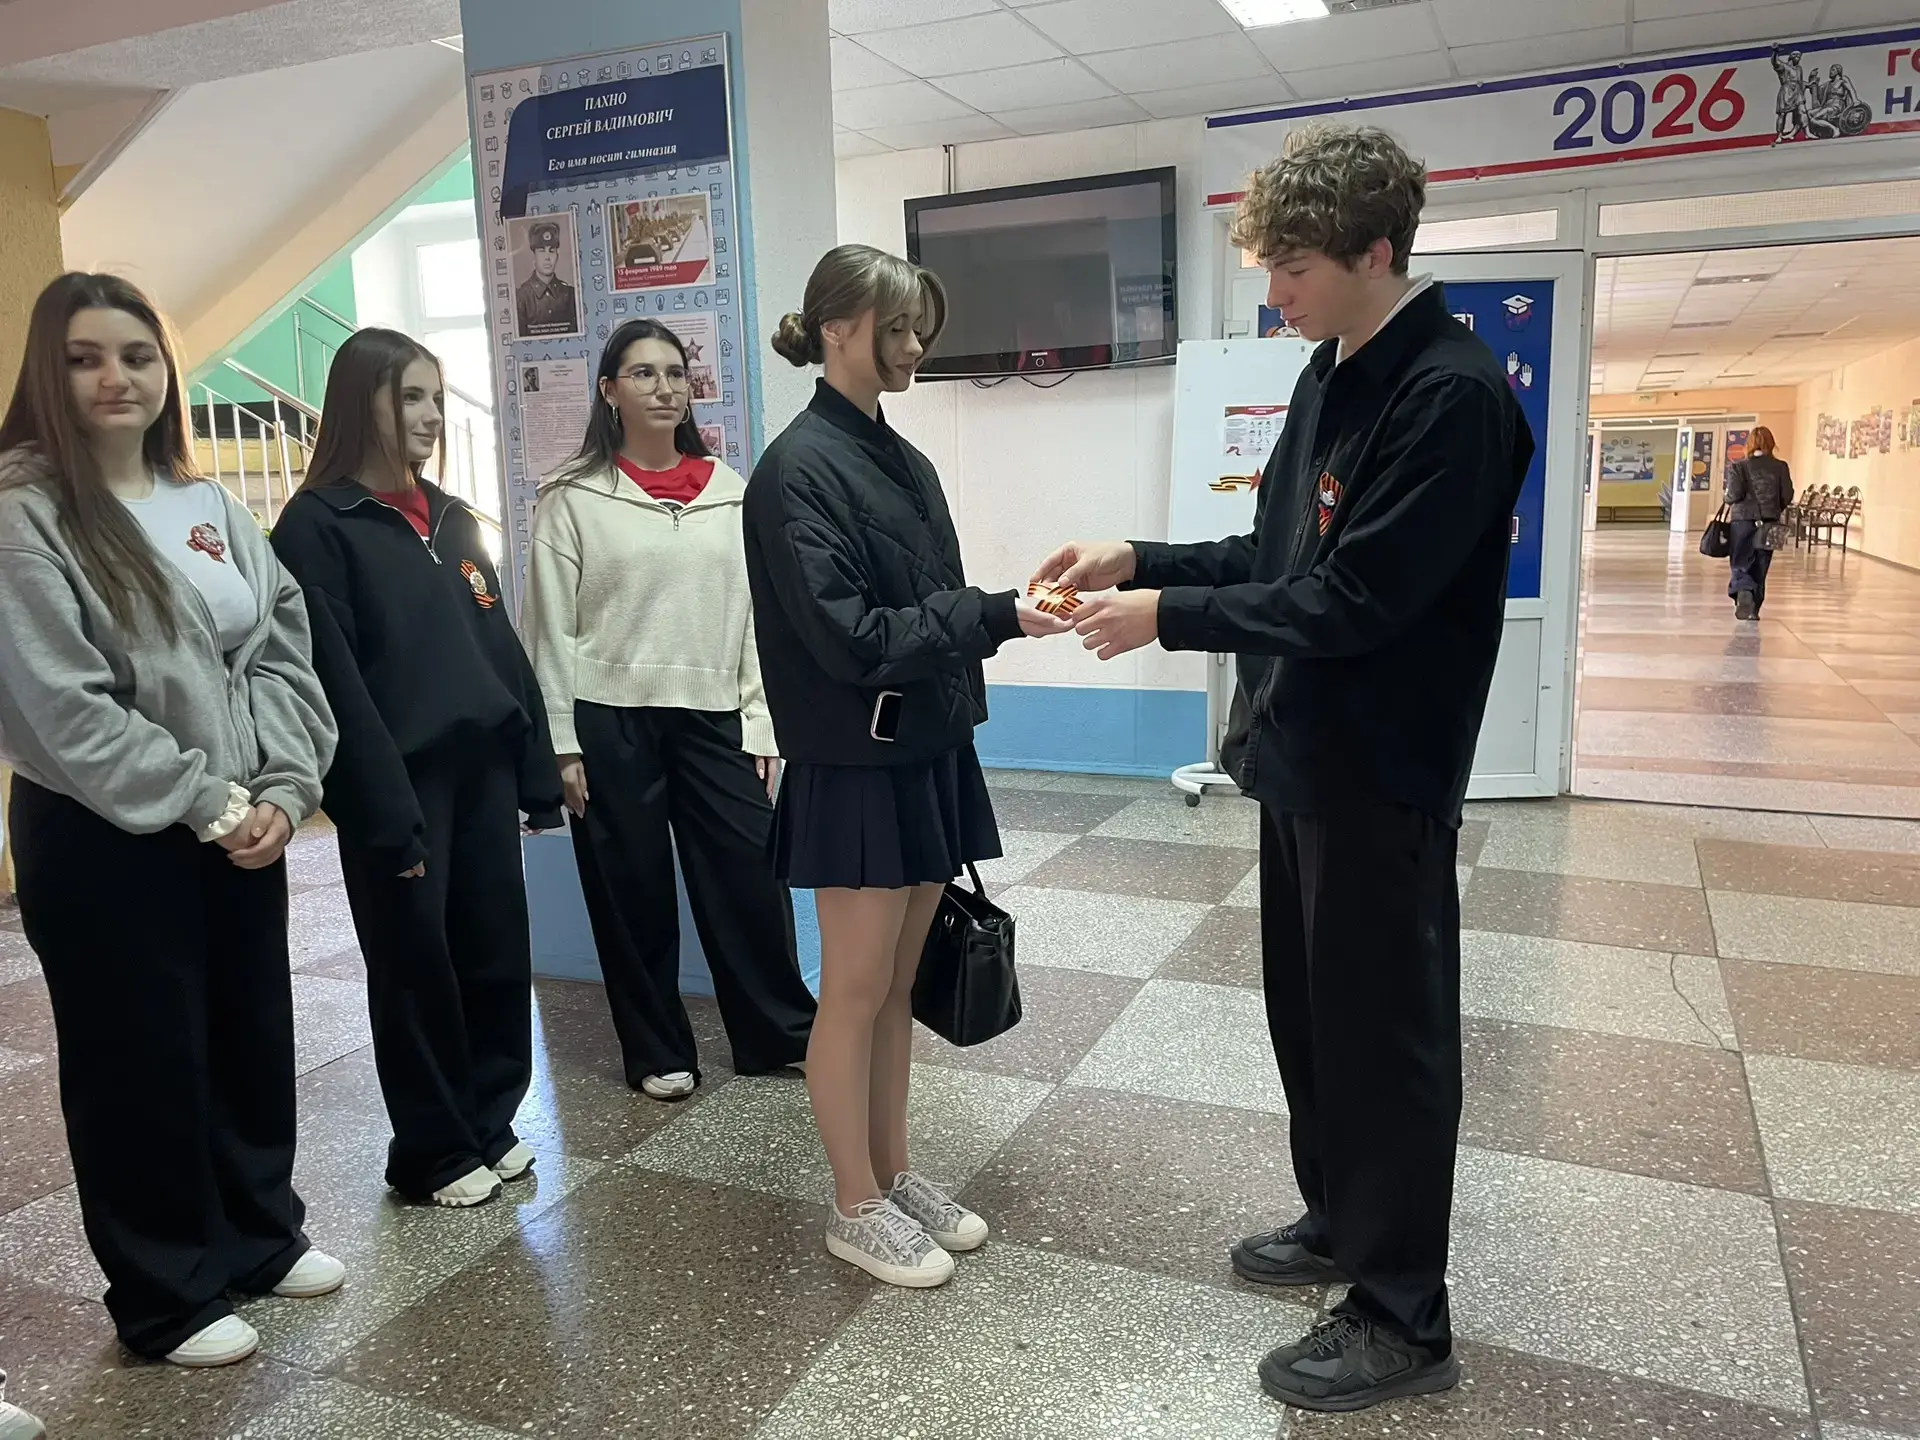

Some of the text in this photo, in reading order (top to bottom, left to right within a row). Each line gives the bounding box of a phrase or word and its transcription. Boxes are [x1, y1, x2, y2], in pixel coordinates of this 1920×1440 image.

[584, 91, 627, 111] ПАХНО
[1552, 67, 1746, 151] 2026
[546, 108, 674, 140] СЕРГЕЙ ВАДИМОВИЧ
[548, 144, 677, 172] Его имя носит гимназия
